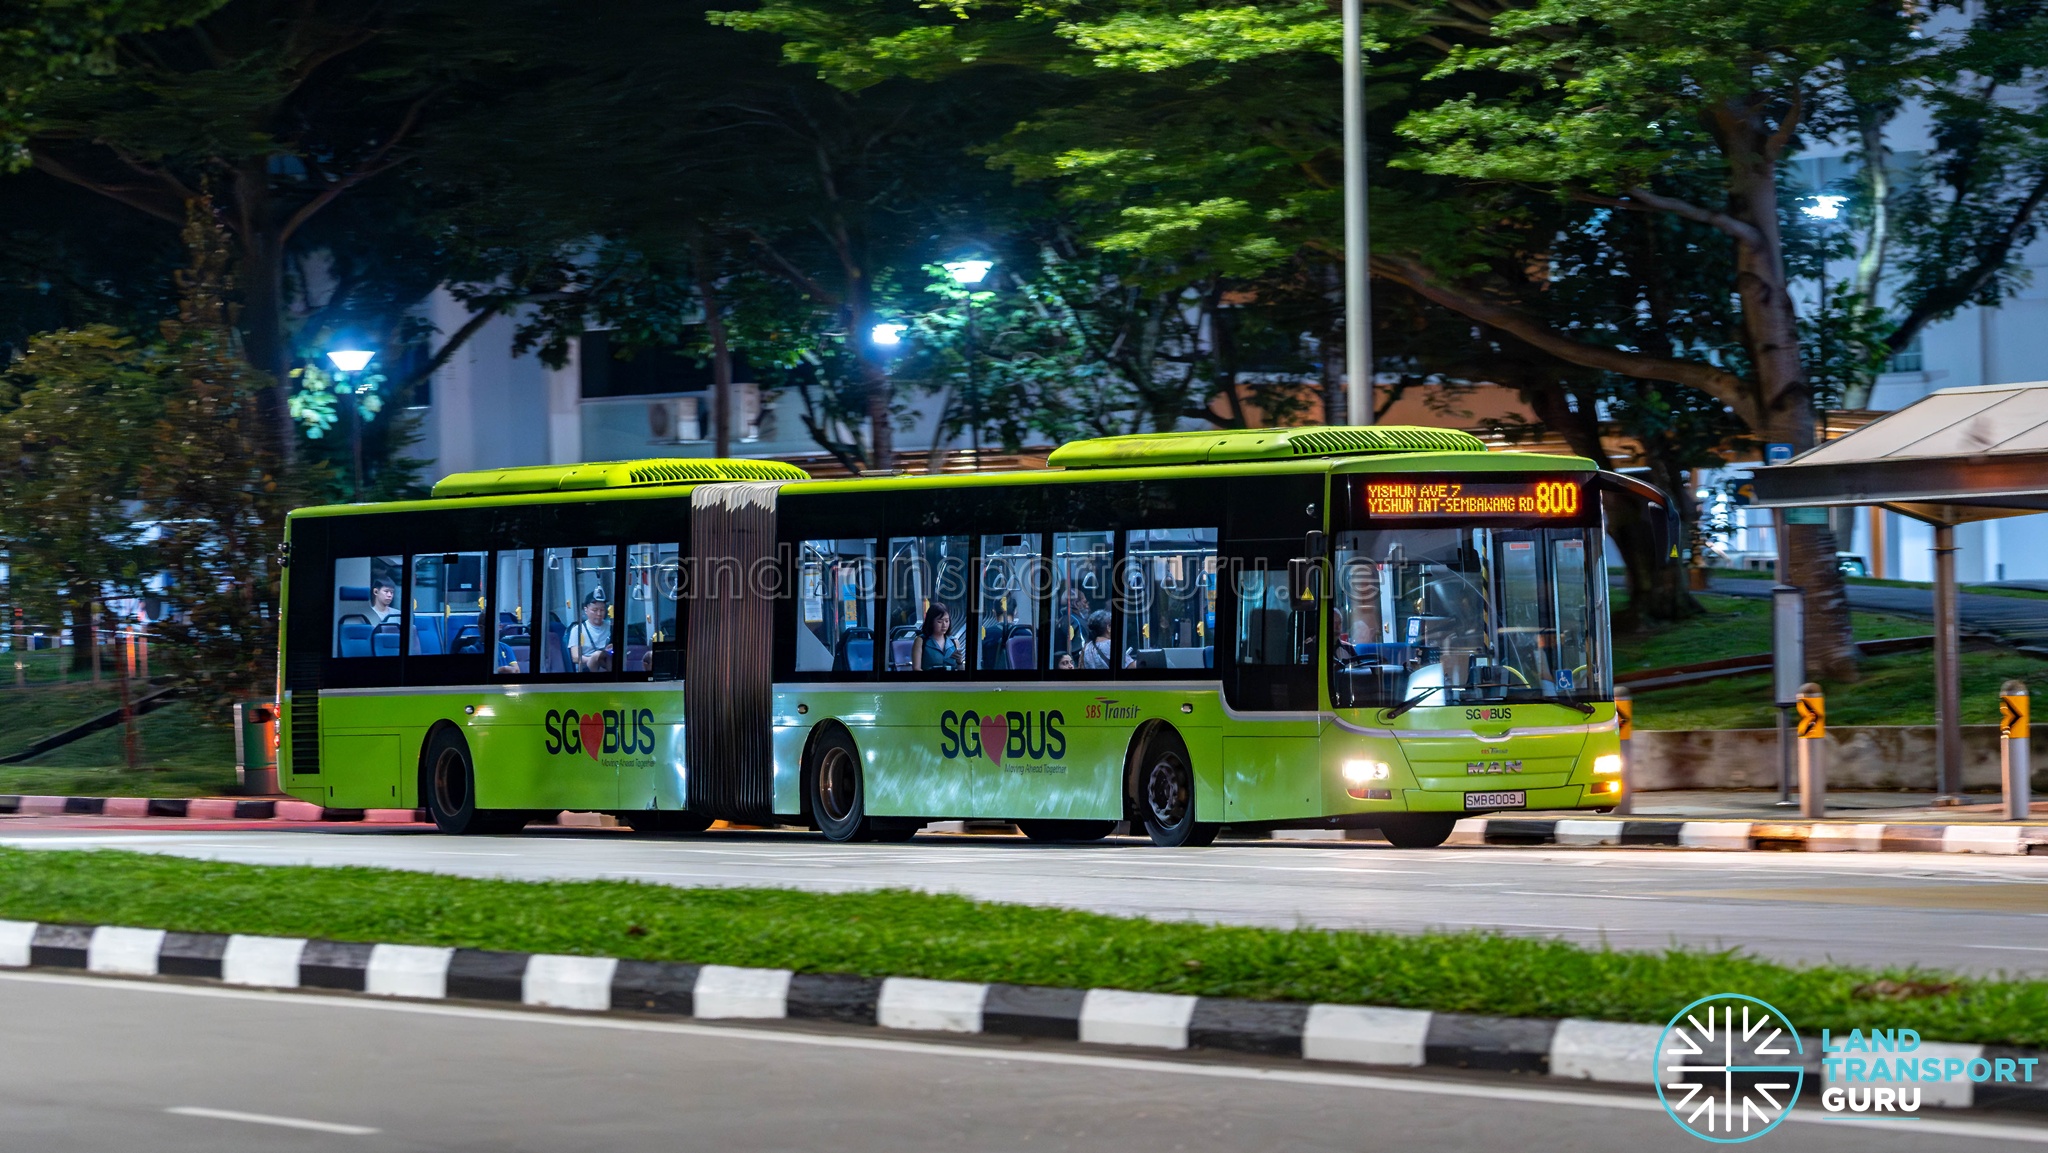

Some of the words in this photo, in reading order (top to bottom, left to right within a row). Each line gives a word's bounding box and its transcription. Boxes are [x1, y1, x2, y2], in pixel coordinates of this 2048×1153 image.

[1368, 485, 1416, 497] YISHUN
[1420, 485, 1447, 497] AVE
[1451, 485, 1461, 497] 7
[1536, 482, 1577, 513] 800
[1368, 498, 1414, 512] YISHUN
[1417, 497, 1515, 512] INT-SEMBAWANG
[1519, 497, 1534, 511] RD
[1085, 704, 1101, 719] SBS
[1100, 699, 1141, 721] Transit
[1467, 760, 1522, 775] MAN
[1466, 793, 1524, 806] SMB8009J
